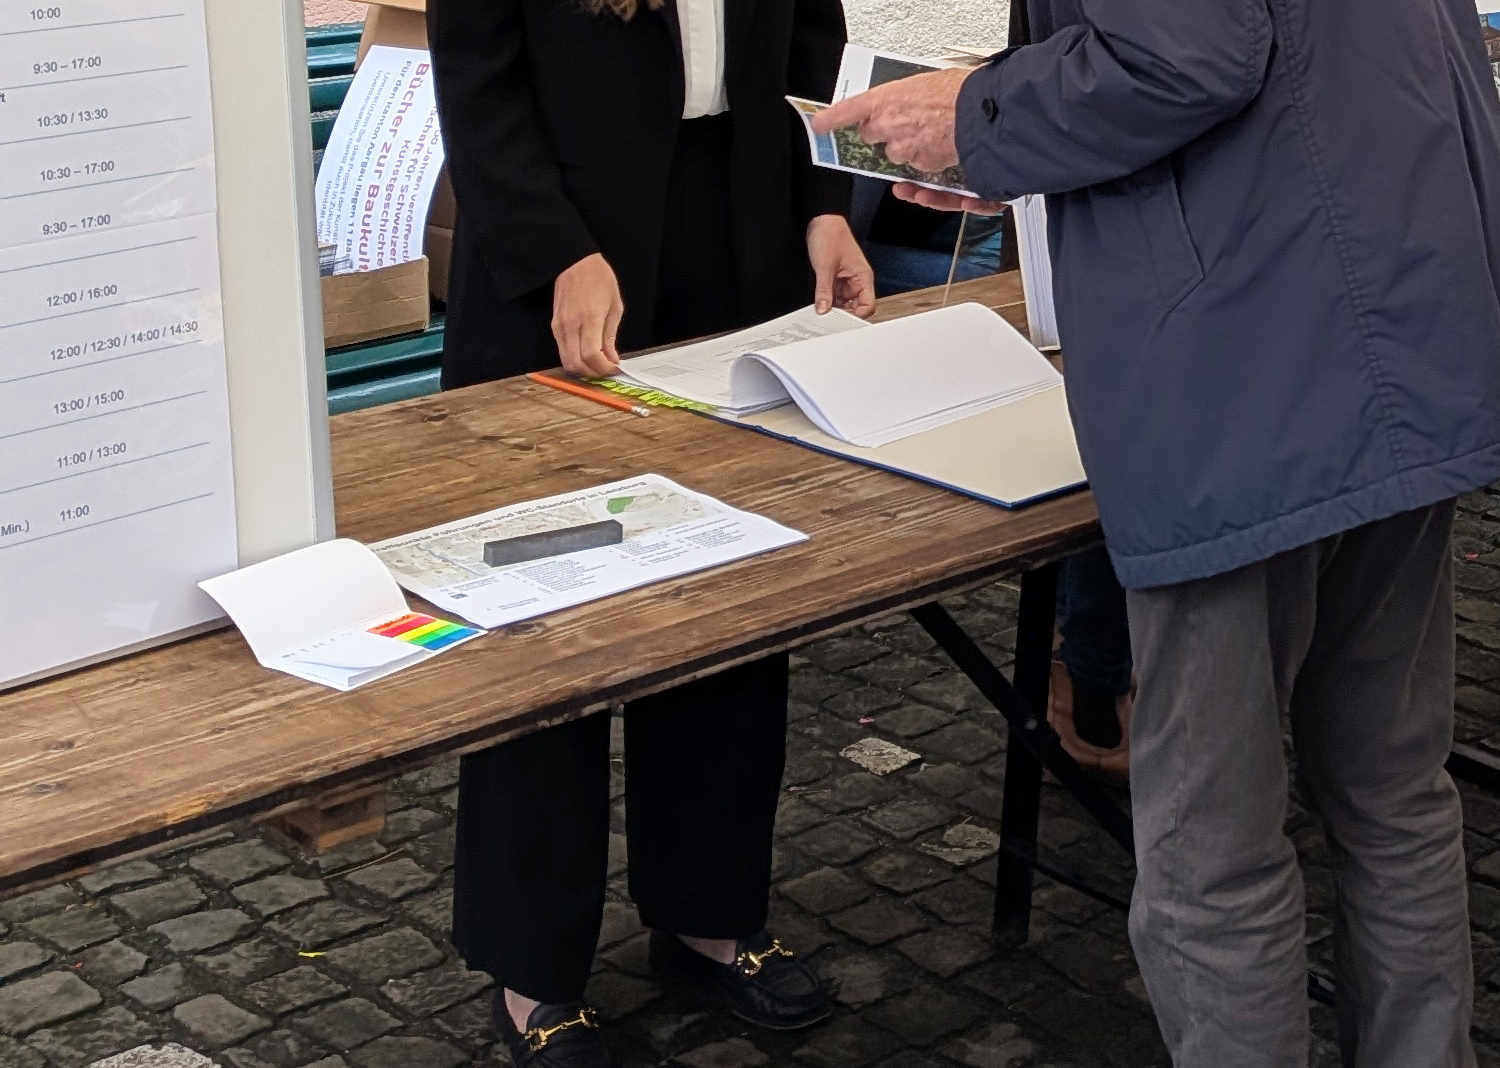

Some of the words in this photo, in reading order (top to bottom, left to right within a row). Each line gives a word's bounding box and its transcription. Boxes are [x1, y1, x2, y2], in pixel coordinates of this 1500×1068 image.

[30, 7, 61, 20] 10:00
[33, 61, 58, 74] 9:30
[71, 56, 102, 70] 17:00
[388, 79, 402, 99] den
[389, 63, 431, 138] Bücher
[36, 113, 68, 128] 10:30
[78, 108, 109, 122] 13:30
[371, 101, 393, 139] Kanton
[40, 166, 71, 182] 10:30
[84, 160, 115, 175] 17:00
[358, 141, 375, 182] Aargau
[374, 141, 393, 180] zur
[405, 158, 418, 181] für
[349, 184, 363, 219] liegen
[377, 139, 412, 267] Kunstgeschichte
[42, 221, 67, 235] 9:30
[80, 214, 111, 229] 17:00
[390, 184, 409, 263] Schweizer
[46, 292, 77, 307] 12:00
[87, 284, 118, 299] 16:00
[50, 345, 81, 361] 12:00
[90, 337, 121, 352] 12:30
[130, 328, 160, 344] 14:00
[169, 321, 199, 336] 14:30
[53, 398, 84, 414] 13:00
[94, 389, 125, 405] 15:00
[57, 451, 87, 468] 11:00
[96, 442, 127, 458] 13:00
[598, 481, 647, 497] Lenzburg
[59, 504, 90, 521] 11:00
